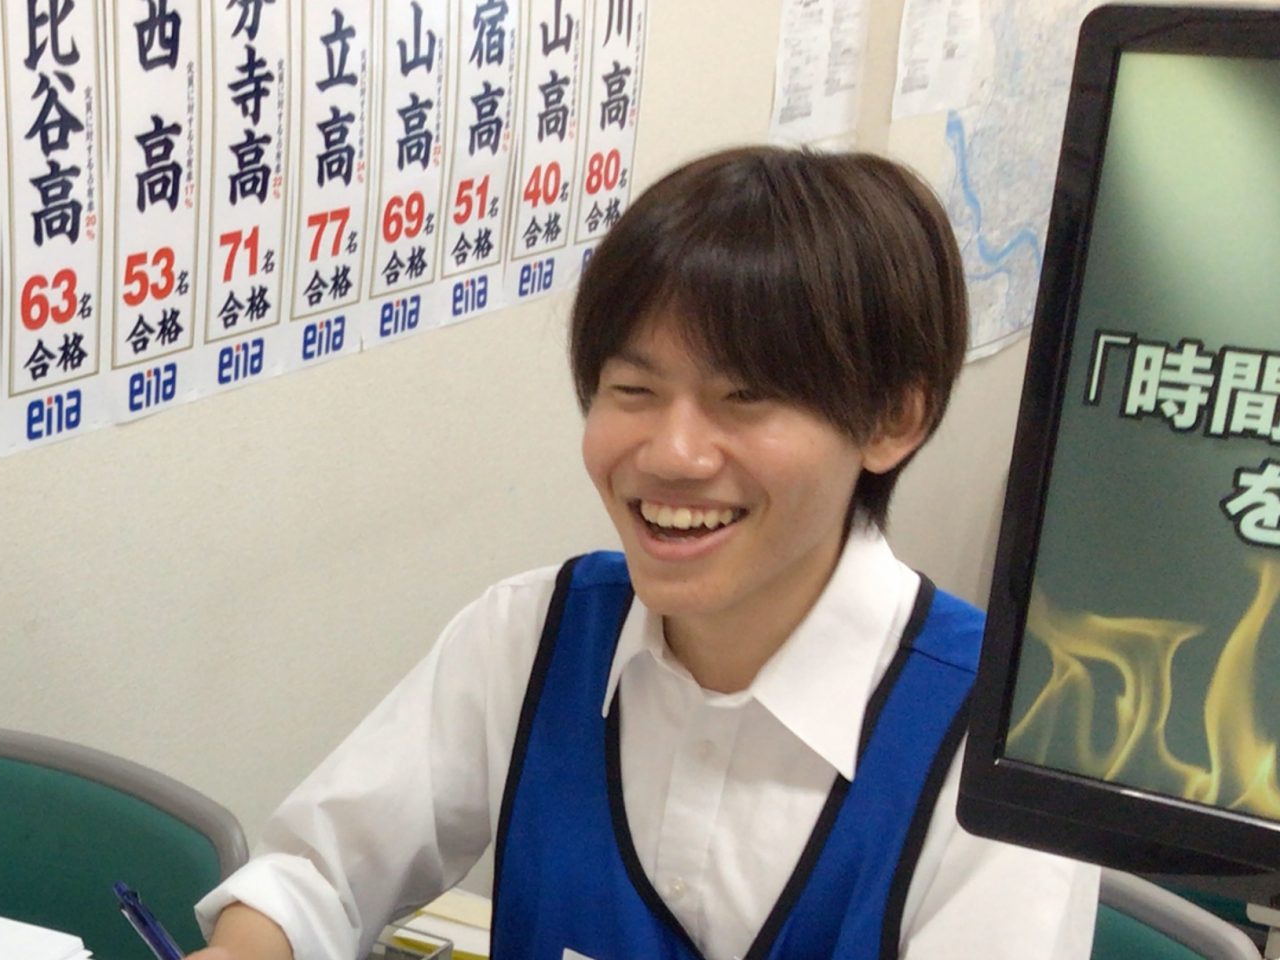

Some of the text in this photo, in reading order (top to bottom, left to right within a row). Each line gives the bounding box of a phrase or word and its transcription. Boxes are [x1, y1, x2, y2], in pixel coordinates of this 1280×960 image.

[397, 1, 436, 171] 山高
[469, 0, 509, 157] 宿高
[538, 0, 574, 143] 山高
[600, 0, 633, 131] 川高
[24, 0, 84, 247] 比谷高
[315, 8, 358, 188] 立高
[382, 191, 434, 243] 69名
[453, 174, 499, 226] 51名
[585, 198, 621, 233] 合格
[219, 225, 274, 283] 71名
[307, 207, 357, 262] 77名
[451, 227, 494, 267] 合格
[523, 212, 562, 249] 合格
[122, 247, 189, 307] 53名
[303, 264, 352, 307] 合格
[382, 245, 428, 286] 合格
[21, 267, 93, 331] 63名
[218, 285, 271, 329] 合格
[24, 332, 88, 380] 合格
[126, 307, 184, 354] 合格
